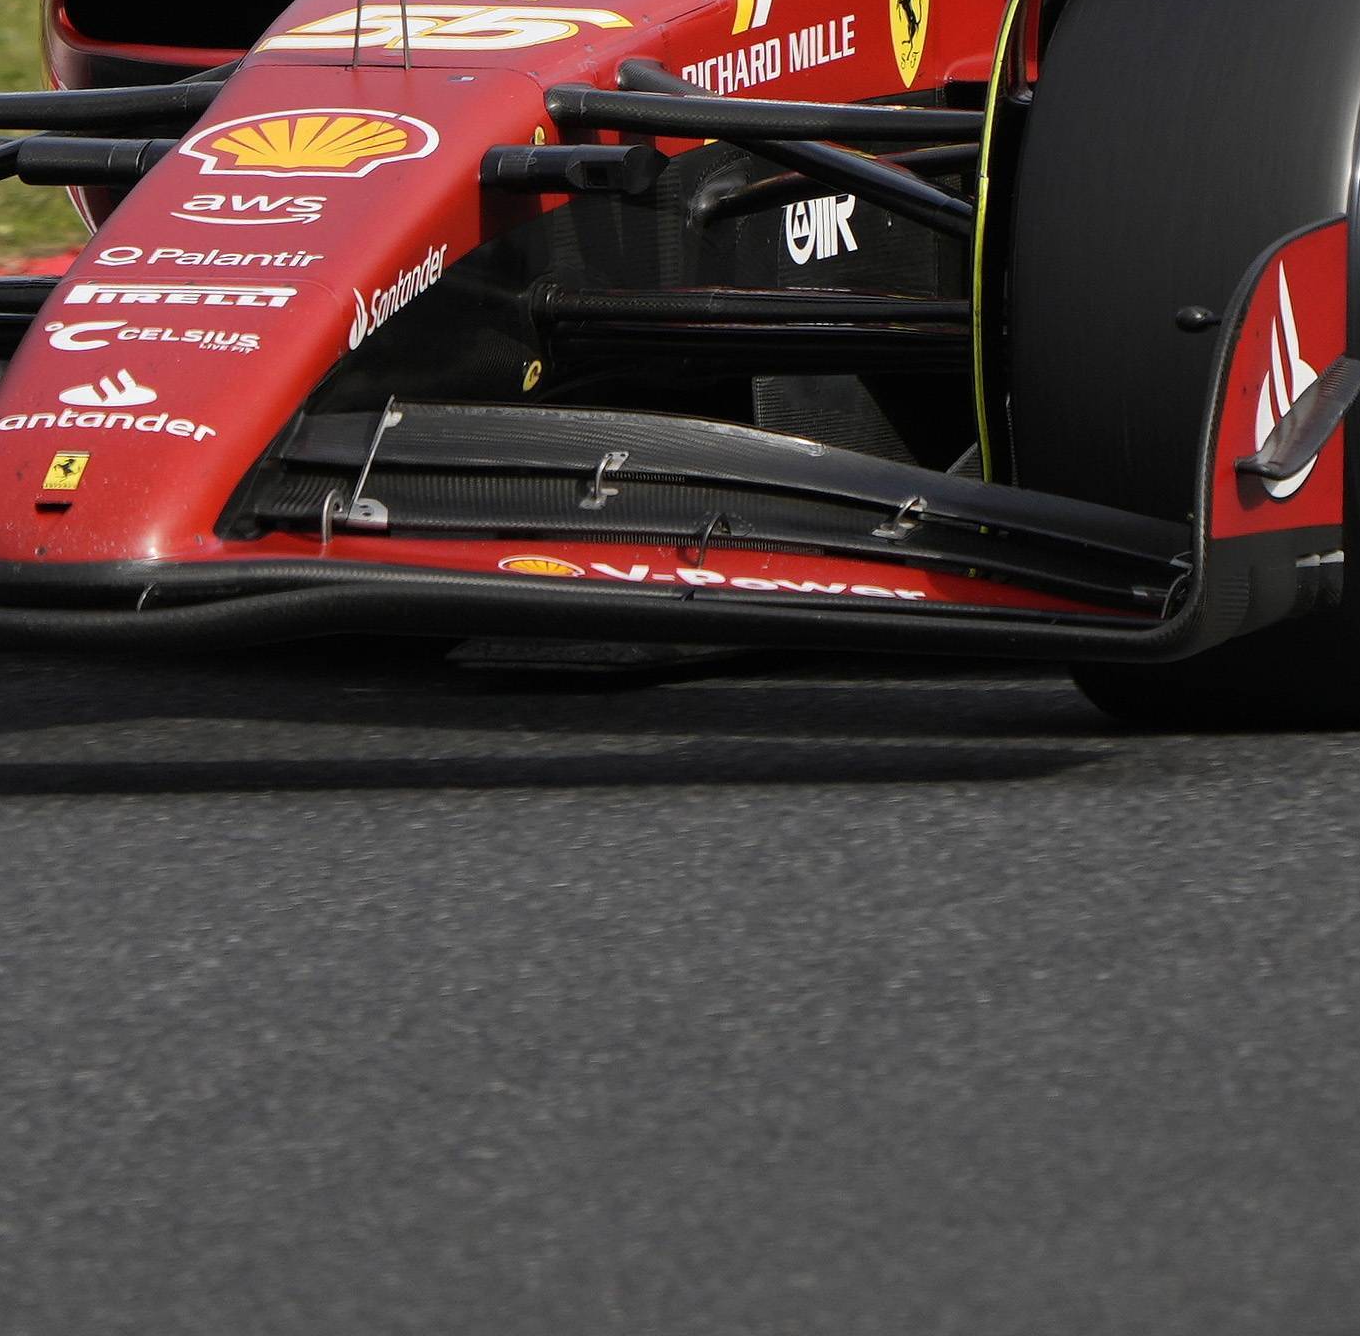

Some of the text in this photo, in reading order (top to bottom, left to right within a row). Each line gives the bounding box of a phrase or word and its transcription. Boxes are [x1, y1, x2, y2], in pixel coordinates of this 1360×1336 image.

[254, 4, 634, 54] 55
[682, 14, 856, 96] RICHARD MILLE
[182, 194, 328, 213] aws
[147, 247, 325, 267] Palantir
[64, 284, 298, 307] PIRELLI
[366, 244, 448, 338] Santander
[117, 326, 261, 348] CELSIUS
[198, 342, 254, 355] LIVE FIT
[590, 562, 926, 601] V-Power
